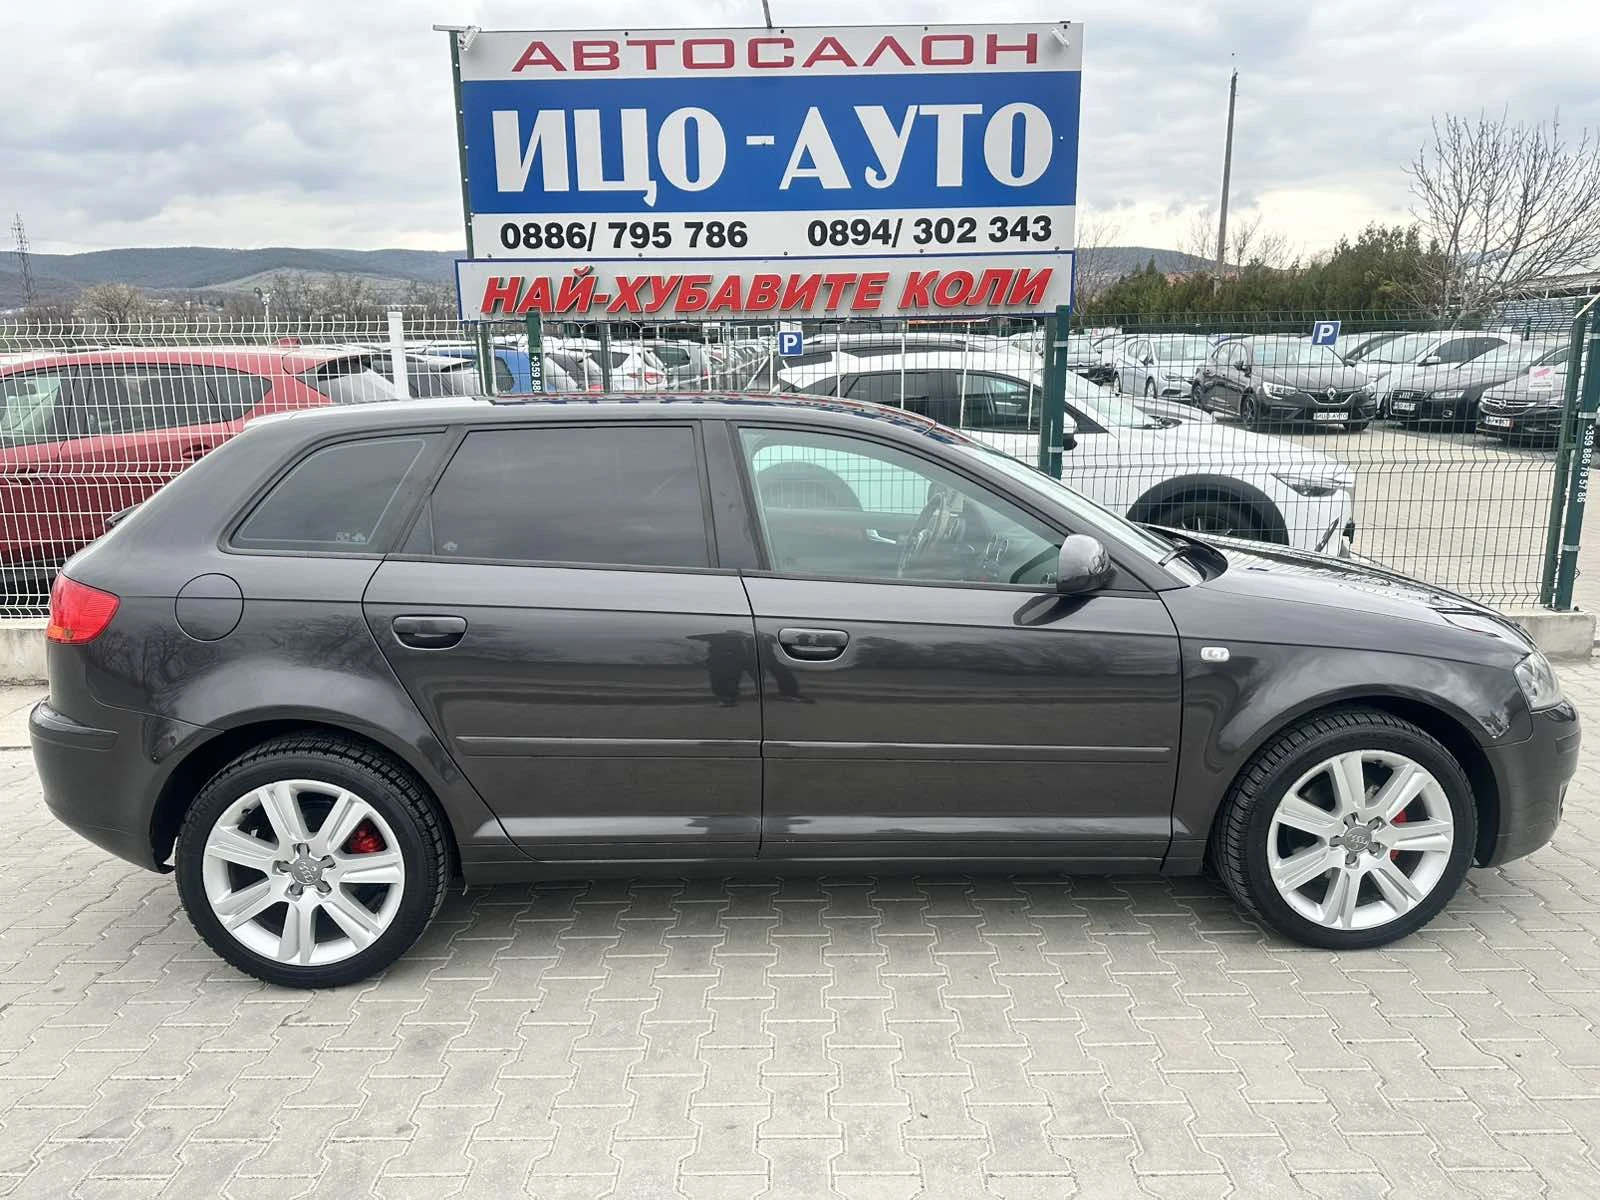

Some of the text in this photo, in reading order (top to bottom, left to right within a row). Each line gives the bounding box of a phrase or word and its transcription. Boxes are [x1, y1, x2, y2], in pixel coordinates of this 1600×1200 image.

[512, 33, 1038, 72] АВТОСАЛОН
[500, 215, 1052, 251] 0886/ 795 786 0894/ 302 343
[480, 265, 1054, 314] НАЙ-ХУБАВИТЕ КОЛИ
[783, 334, 798, 353] P
[1317, 324, 1335, 344] P
[531, 355, 542, 392] +359 88
[1584, 424, 1595, 446] +359
[1582, 448, 1592, 464] 886
